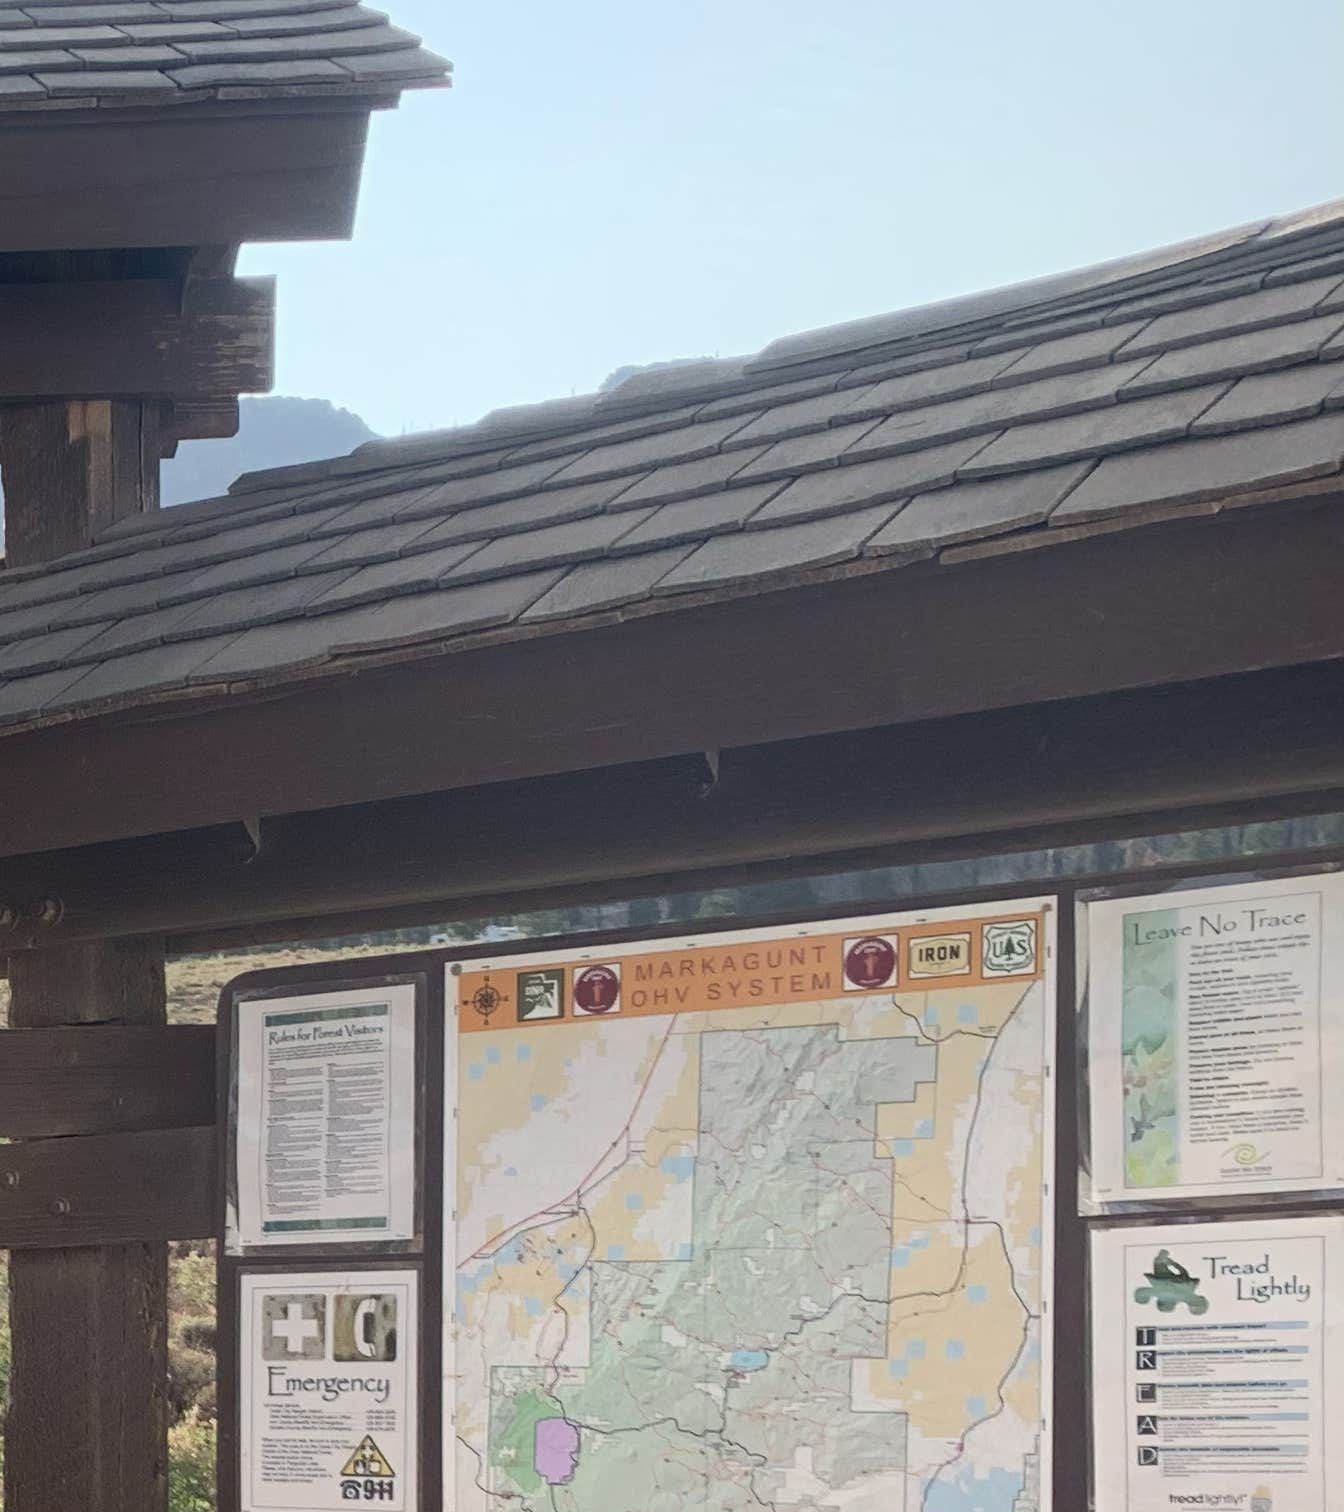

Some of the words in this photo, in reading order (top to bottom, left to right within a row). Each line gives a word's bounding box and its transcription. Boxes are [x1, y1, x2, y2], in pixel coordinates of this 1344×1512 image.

[1132, 922, 1193, 946] Leave
[1200, 913, 1237, 937] No
[1242, 908, 1307, 932] Trace
[634, 945, 827, 981] MARKAGUNT
[918, 944, 961, 962] IRON
[631, 986, 689, 1008] OHV
[707, 972, 831, 1001] SYSTEM
[269, 1030, 296, 1045] Rules
[297, 1028, 312, 1040] for
[312, 1026, 343, 1041] Forest
[344, 1024, 384, 1037] Visitors
[1202, 1254, 1270, 1279] Tread
[1237, 1275, 1311, 1303] Lightly
[267, 1366, 390, 1403] Emergency
[363, 1480, 394, 1501] 911
